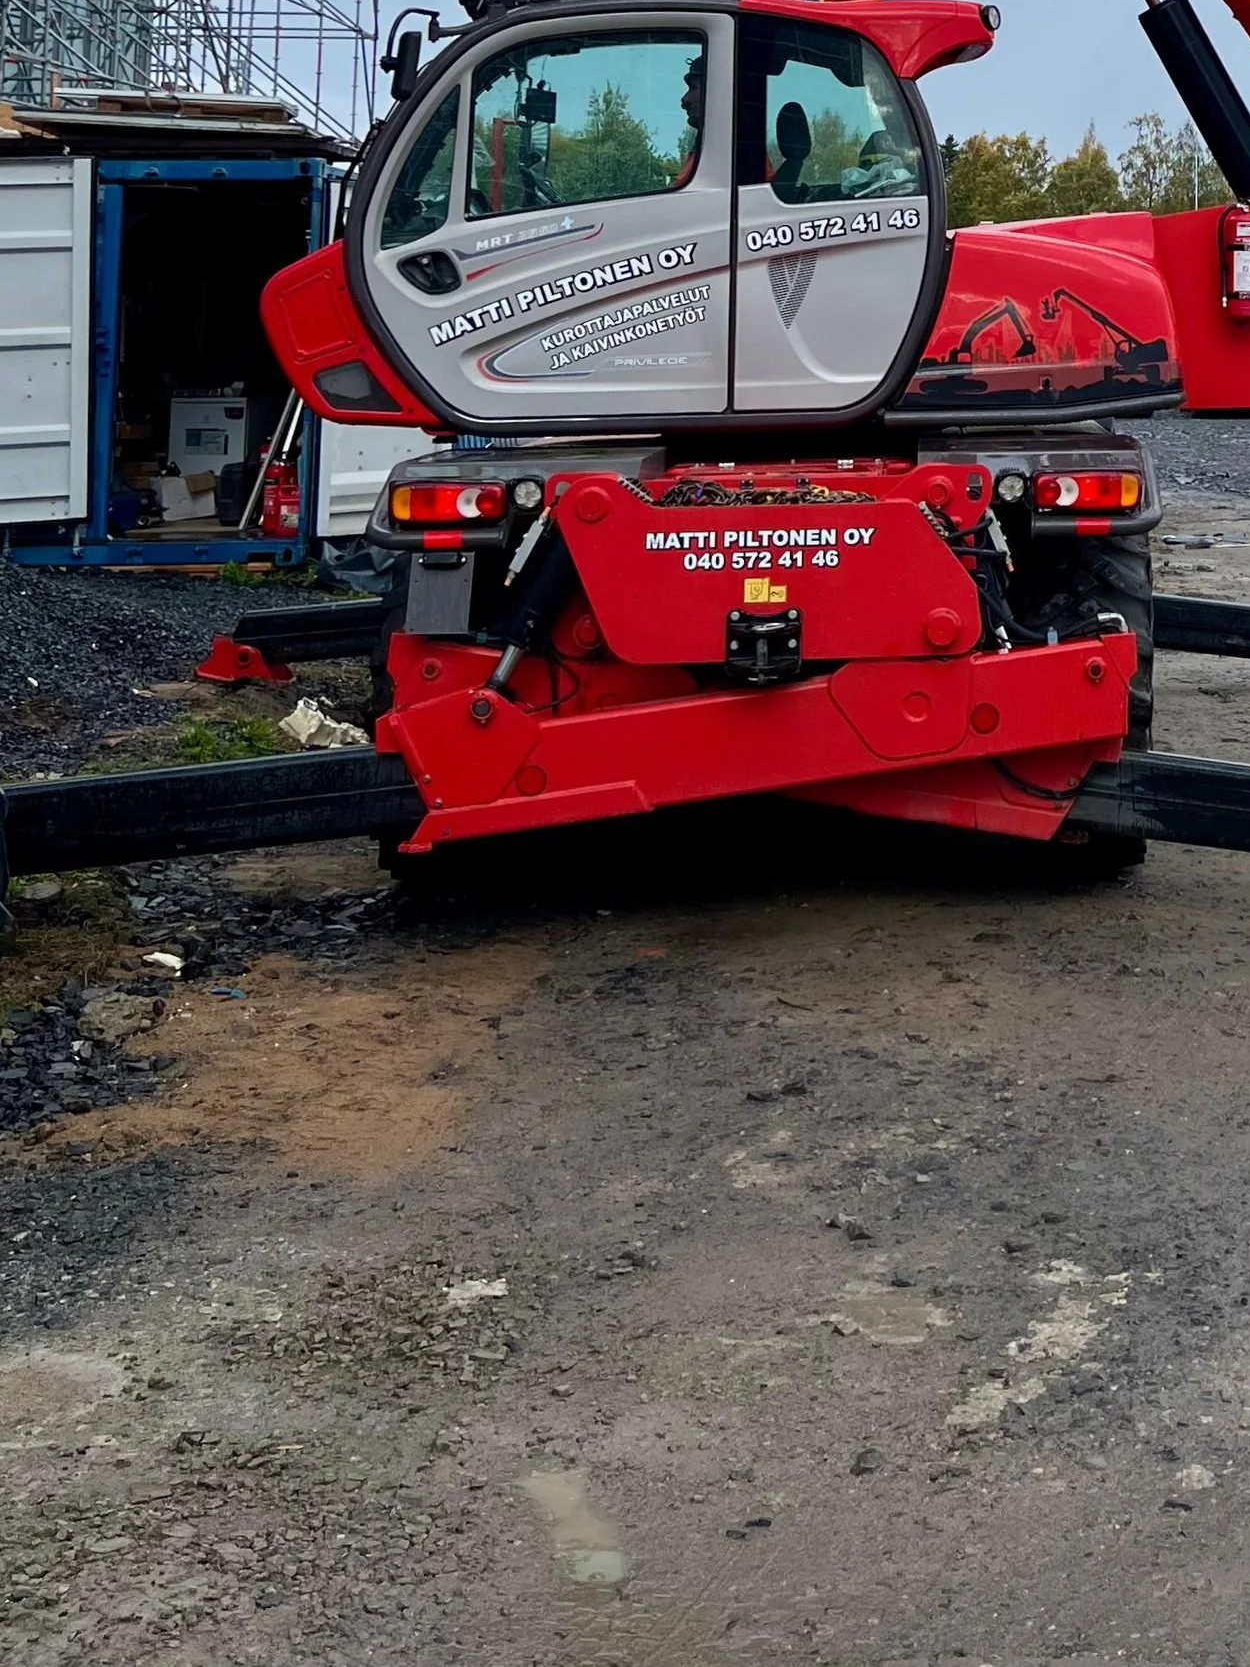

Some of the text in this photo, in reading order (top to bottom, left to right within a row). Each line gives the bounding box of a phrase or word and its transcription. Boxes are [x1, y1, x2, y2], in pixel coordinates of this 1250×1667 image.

[476, 233, 513, 250] MRT
[747, 209, 920, 251] 040 572 41 46
[429, 243, 698, 346] MATTI PILTONEN OY
[540, 285, 711, 352] KUROTTAJAPALVELUT
[550, 306, 706, 370] JA KAIVINKONETYÖT
[614, 357, 688, 367] PRIVILEGE
[645, 528, 875, 550] MATTI PILTONEN OY
[684, 550, 839, 570] 040 572 41 46
